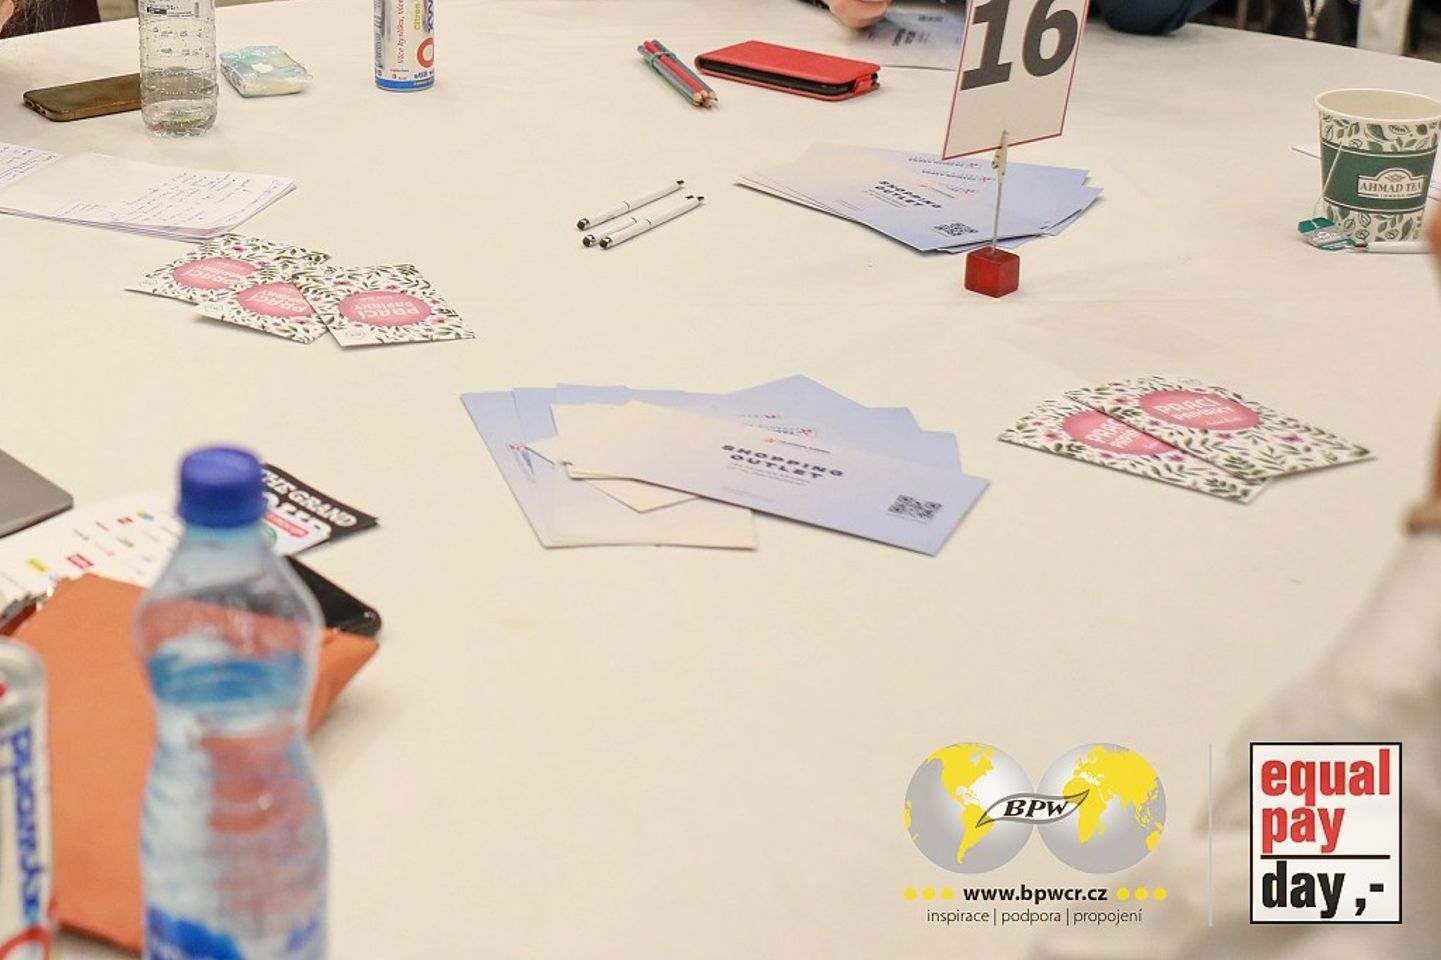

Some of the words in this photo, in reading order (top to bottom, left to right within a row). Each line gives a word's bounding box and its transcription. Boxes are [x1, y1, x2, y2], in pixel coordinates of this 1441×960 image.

[1360, 182, 1404, 193] AHMAD
[1405, 182, 1421, 192] TEA
[721, 445, 843, 476] SHOPPING
[730, 455, 823, 478] OUTLET
[288, 490, 358, 527] GRAND
